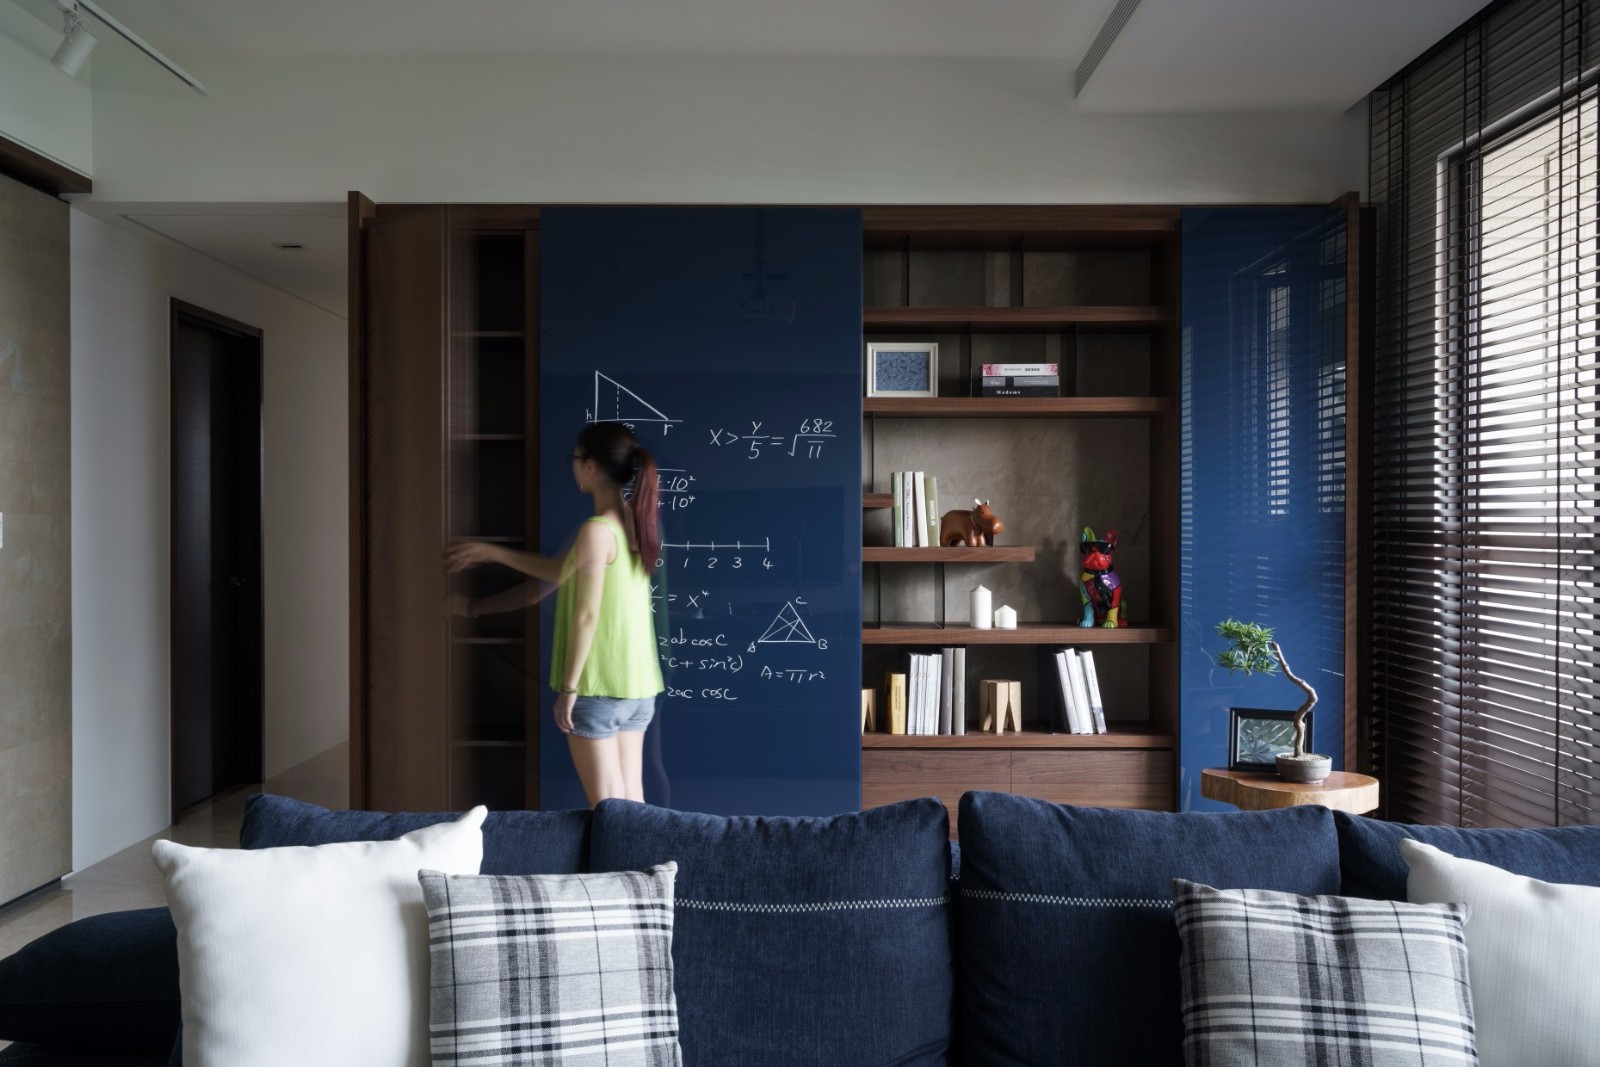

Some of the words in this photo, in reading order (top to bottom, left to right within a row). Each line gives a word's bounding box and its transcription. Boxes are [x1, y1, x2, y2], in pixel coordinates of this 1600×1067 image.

[800, 418, 833, 434] 682
[683, 558, 689, 568] 1
[707, 557, 718, 569] 2
[732, 556, 742, 569] 3
[762, 557, 774, 570] 4
